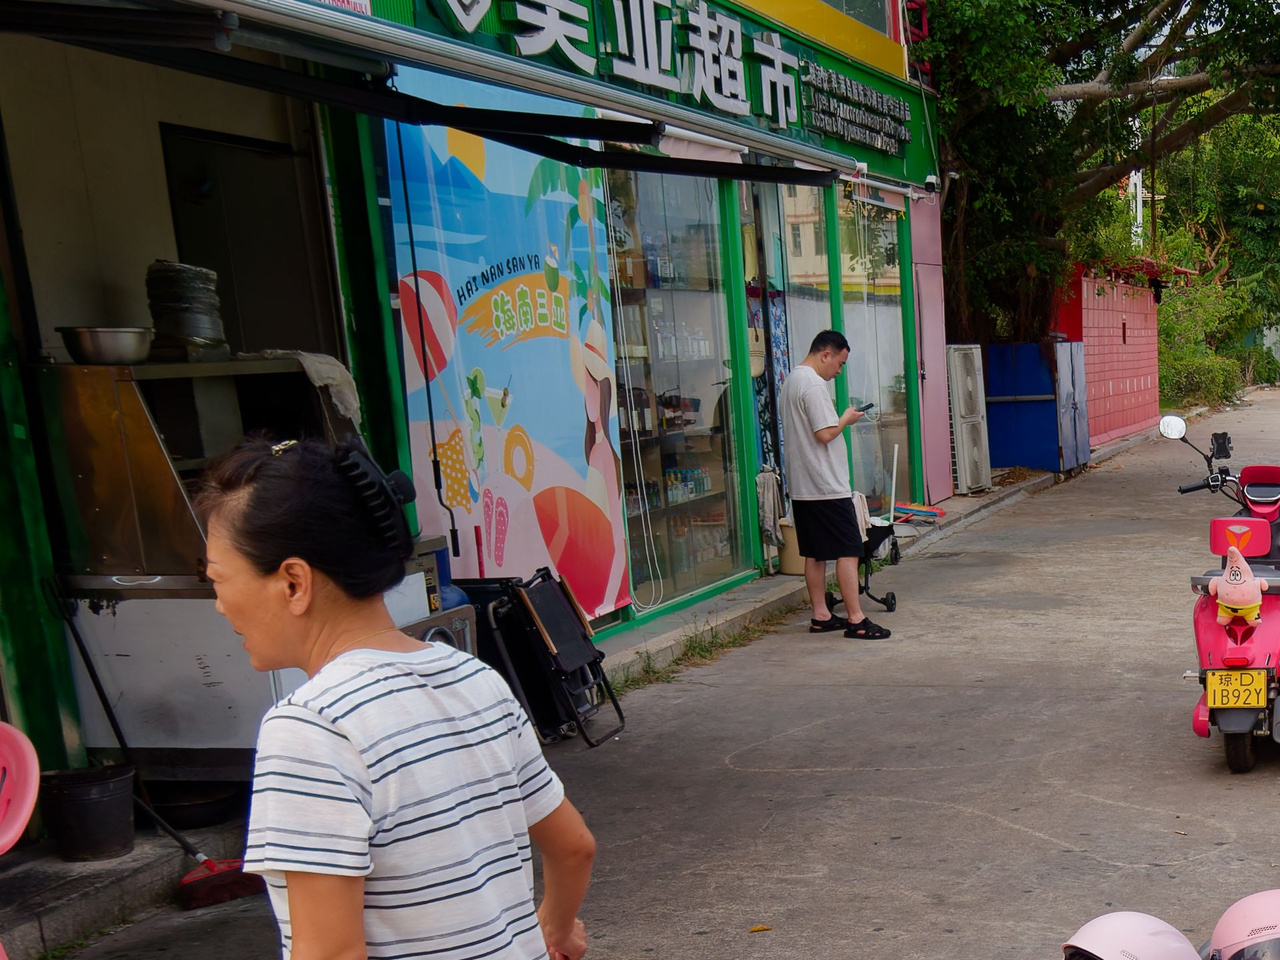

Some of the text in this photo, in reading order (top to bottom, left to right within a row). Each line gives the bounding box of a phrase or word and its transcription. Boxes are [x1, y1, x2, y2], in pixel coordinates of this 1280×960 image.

[456, 253, 541, 307] HAI NAN SAN YA
[491, 284, 568, 340] 海南三亚
[1212, 688, 1263, 706] 1B92Y
